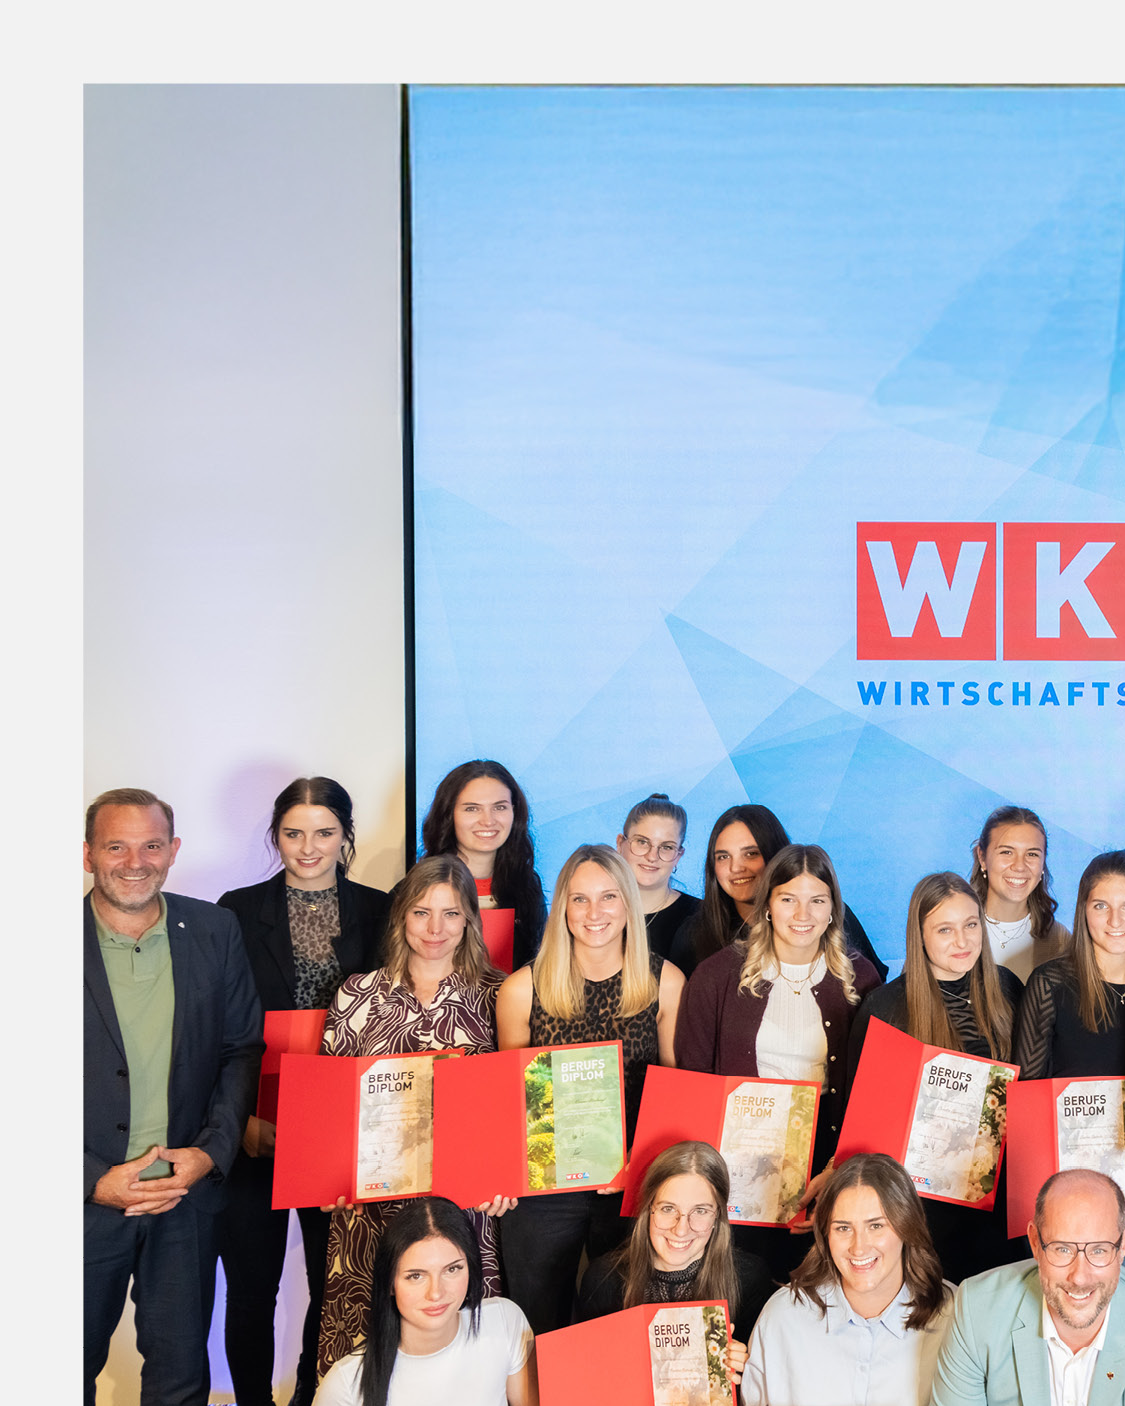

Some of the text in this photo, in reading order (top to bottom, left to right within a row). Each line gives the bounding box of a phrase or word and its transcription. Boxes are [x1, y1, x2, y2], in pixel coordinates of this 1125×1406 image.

[561, 1059, 605, 1072] BERUFS
[368, 1071, 414, 1083] BERUFS
[562, 1071, 604, 1083] DIPLOM
[930, 1065, 972, 1082] BERUFS
[368, 1081, 412, 1094] DIPLOM
[928, 1076, 968, 1093] DIPLOM
[734, 1096, 775, 1107] BERUFS
[1064, 1095, 1106, 1106] BERUFS
[733, 1107, 772, 1118] DIPLOM
[1064, 1106, 1105, 1117] DIPLOM
[654, 1324, 690, 1335] BERUFS
[655, 1336, 690, 1347] DIPLOM
